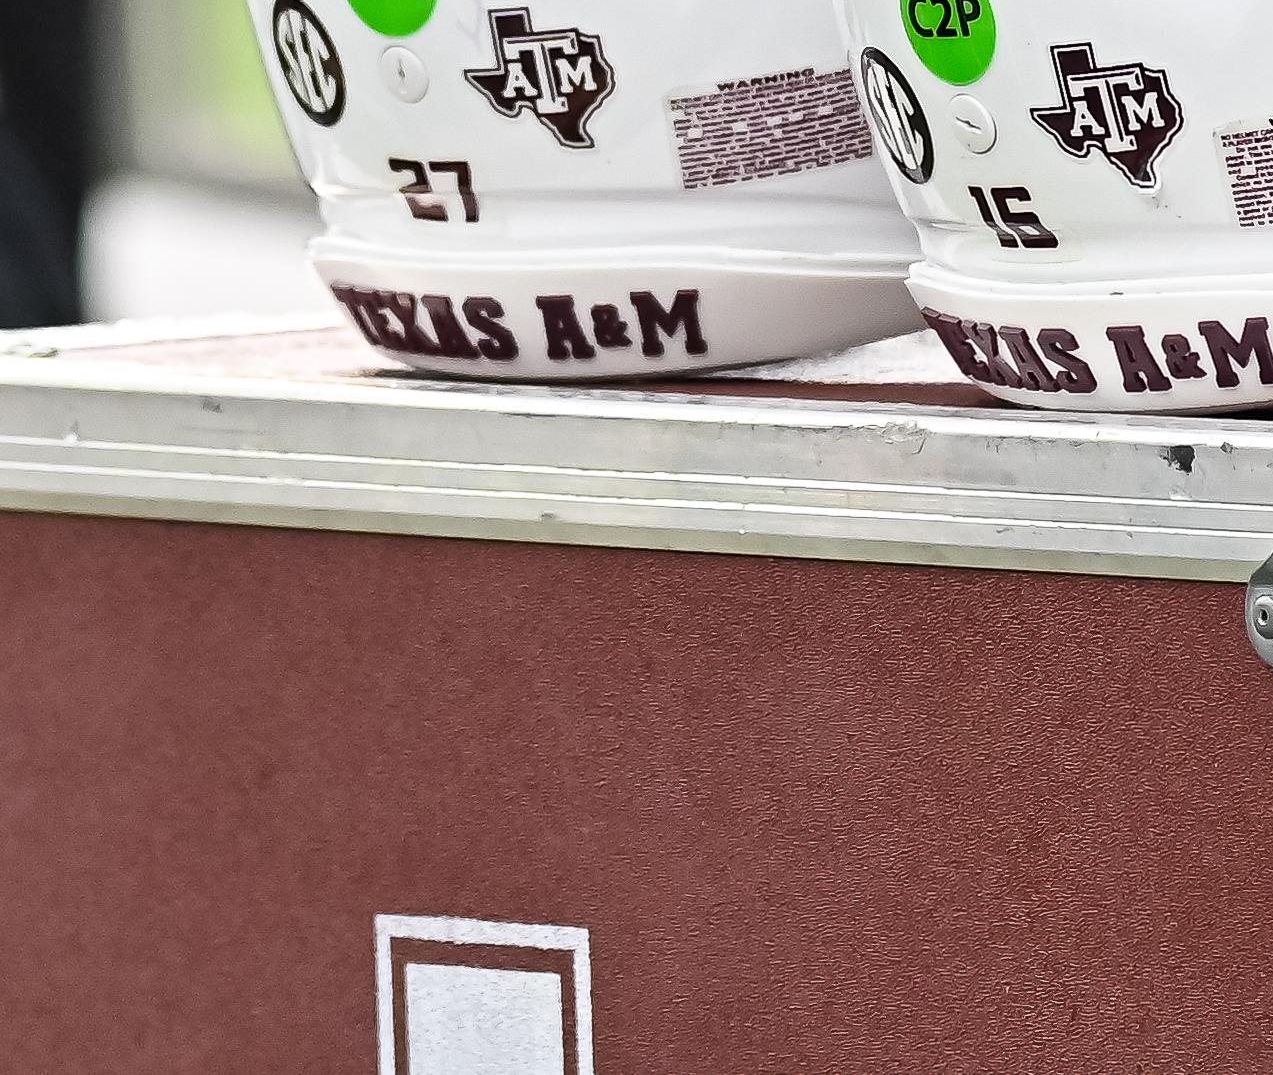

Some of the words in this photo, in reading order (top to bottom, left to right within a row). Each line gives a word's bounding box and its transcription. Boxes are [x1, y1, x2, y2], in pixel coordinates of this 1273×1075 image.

[277, 9, 337, 114] SEC
[717, 67, 815, 92] WARNING
[387, 158, 479, 223] 27
[330, 282, 520, 361] TEXAS
[533, 288, 709, 361] A&M
